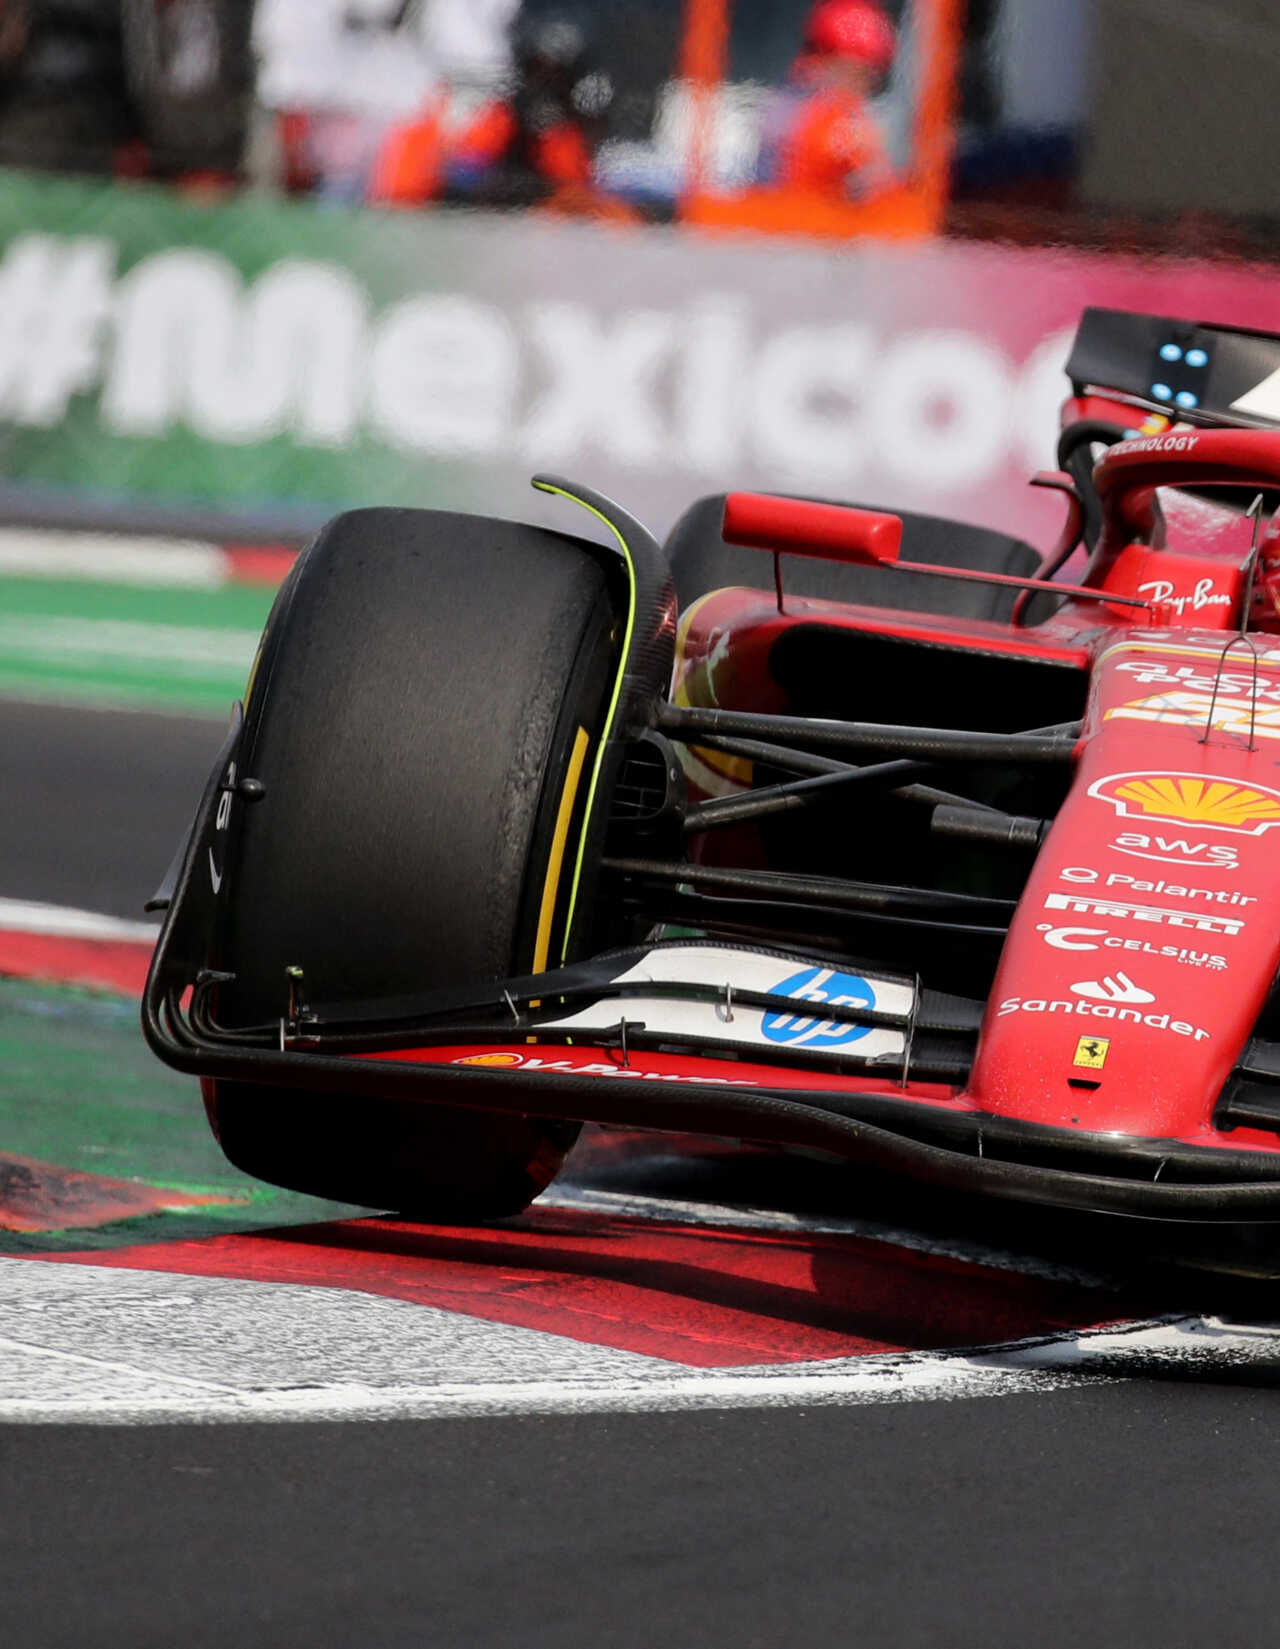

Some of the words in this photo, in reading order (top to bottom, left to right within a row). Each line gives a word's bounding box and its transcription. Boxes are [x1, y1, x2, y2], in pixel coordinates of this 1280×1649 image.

[1137, 578, 1233, 616] Ray-Ban
[1114, 831, 1240, 861] aws
[1105, 872, 1258, 908] Palantir
[1043, 892, 1246, 937] PIRELLI
[1103, 935, 1229, 968] CELSIUS
[764, 967, 872, 1046] hp
[996, 996, 1213, 1042] Santander
